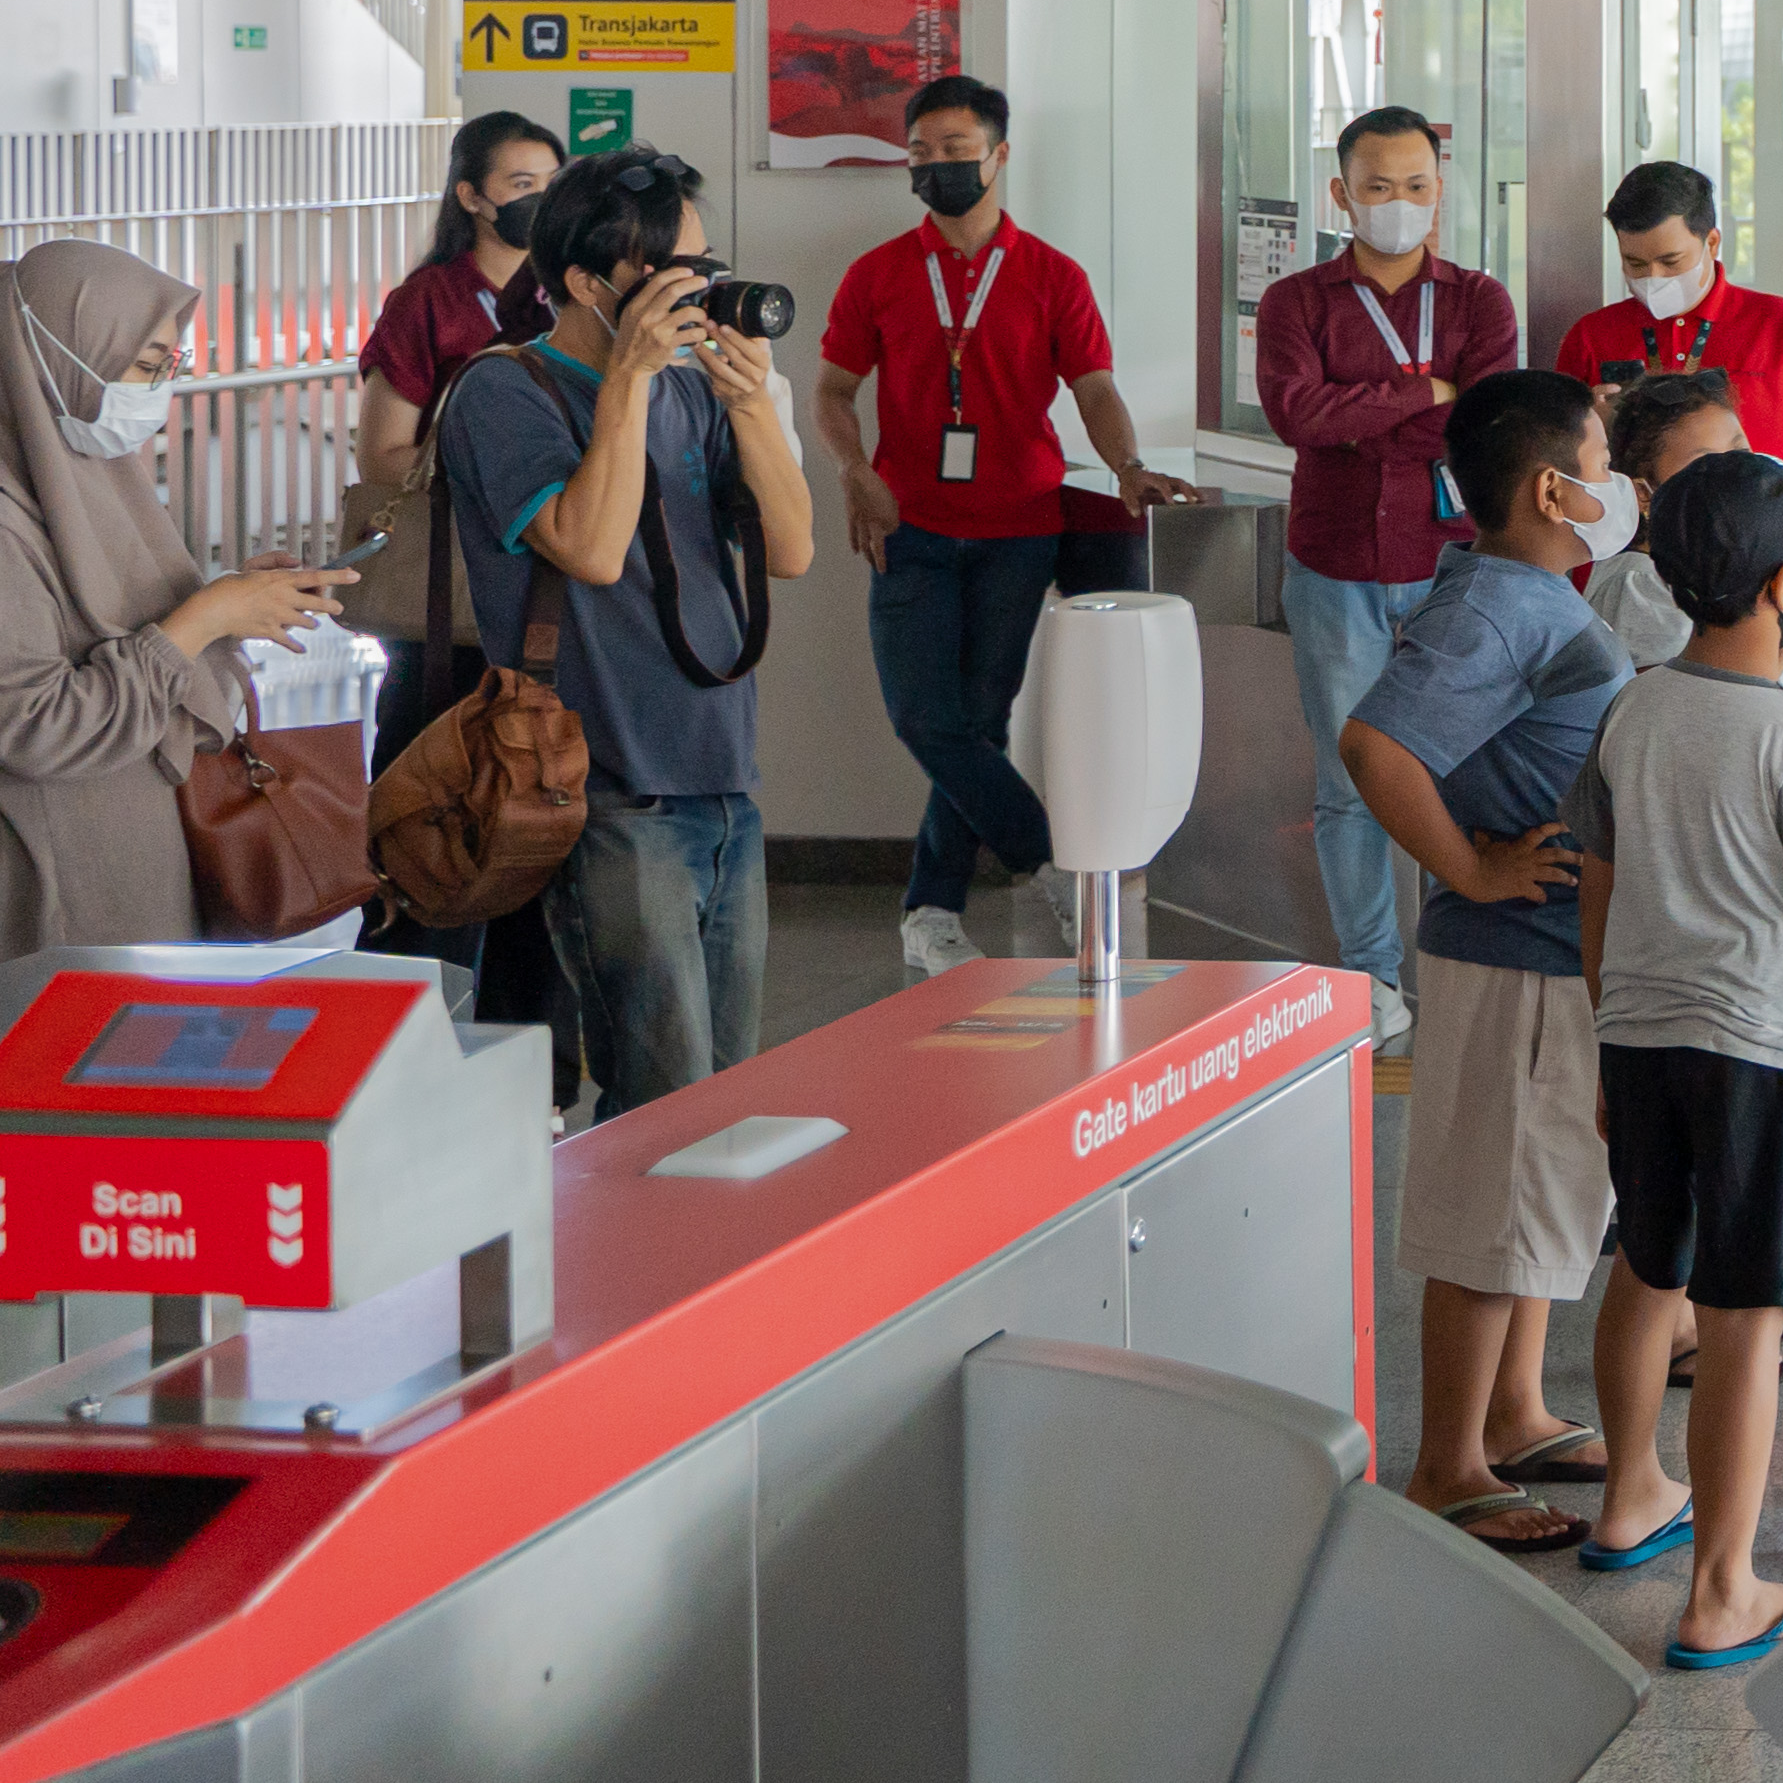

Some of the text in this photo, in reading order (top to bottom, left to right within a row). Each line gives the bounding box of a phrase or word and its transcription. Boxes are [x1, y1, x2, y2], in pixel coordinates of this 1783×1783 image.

[578, 14, 699, 37] Transjakarta
[1073, 977, 1334, 1159] Gate kartu uang elektronik
[93, 1181, 182, 1220] Scan
[79, 1224, 197, 1262] Di Sini
